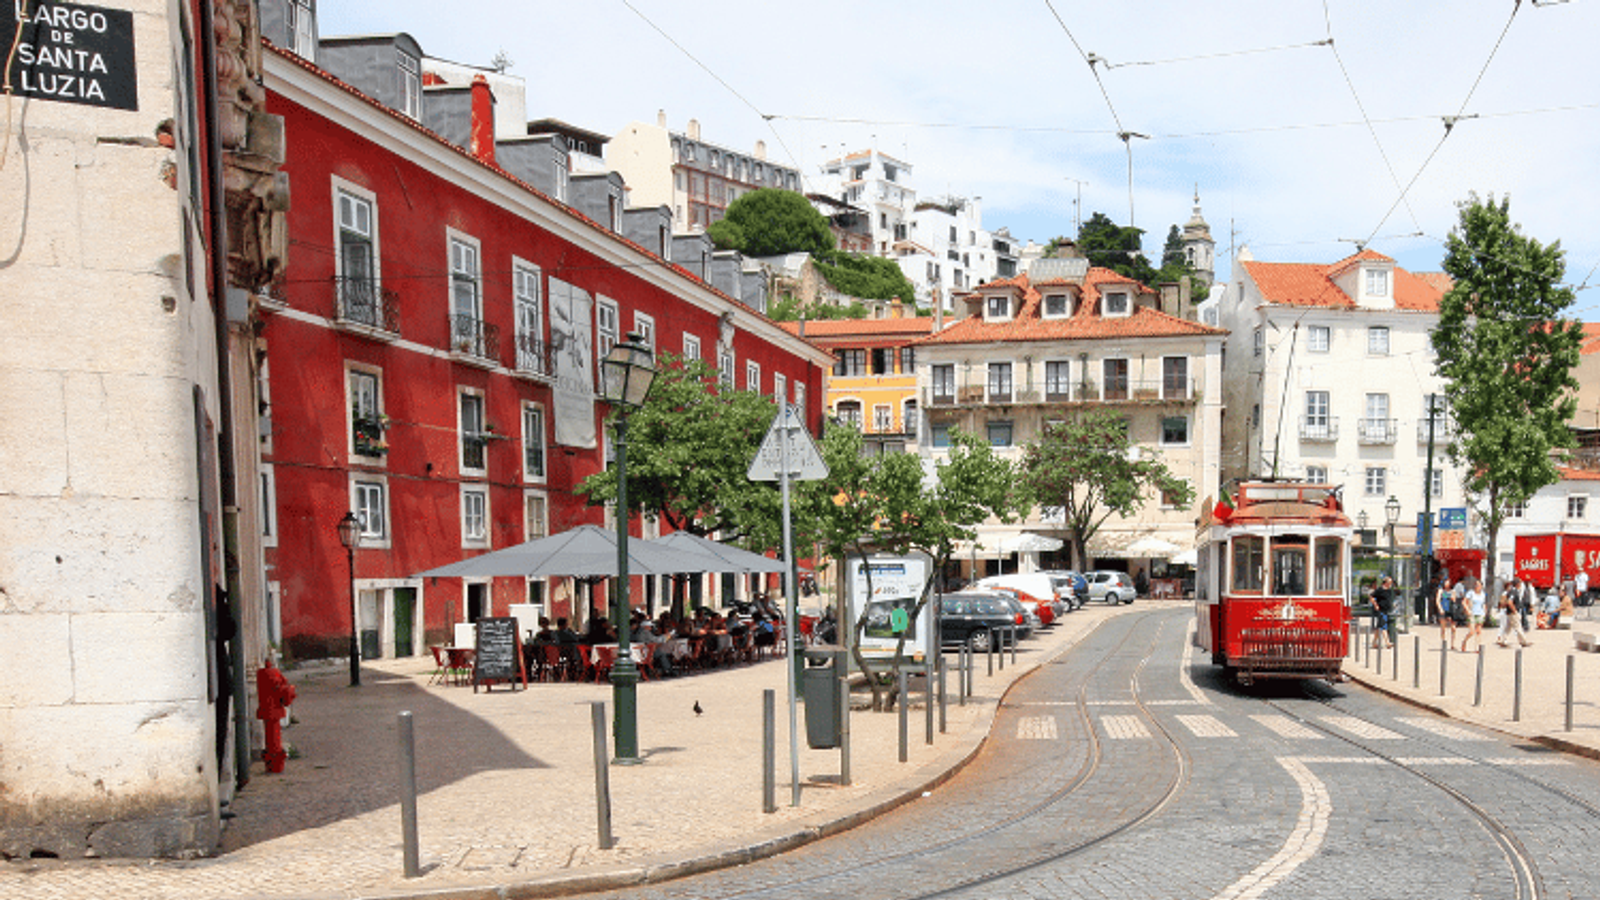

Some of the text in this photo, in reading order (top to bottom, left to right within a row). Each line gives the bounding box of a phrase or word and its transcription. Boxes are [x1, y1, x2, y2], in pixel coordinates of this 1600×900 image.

[14, 0, 108, 33] LARGO
[51, 29, 74, 44] DE
[18, 42, 108, 74] SANTA
[21, 70, 106, 101] LUZIA
[1520, 559, 1549, 571] SAGRES
